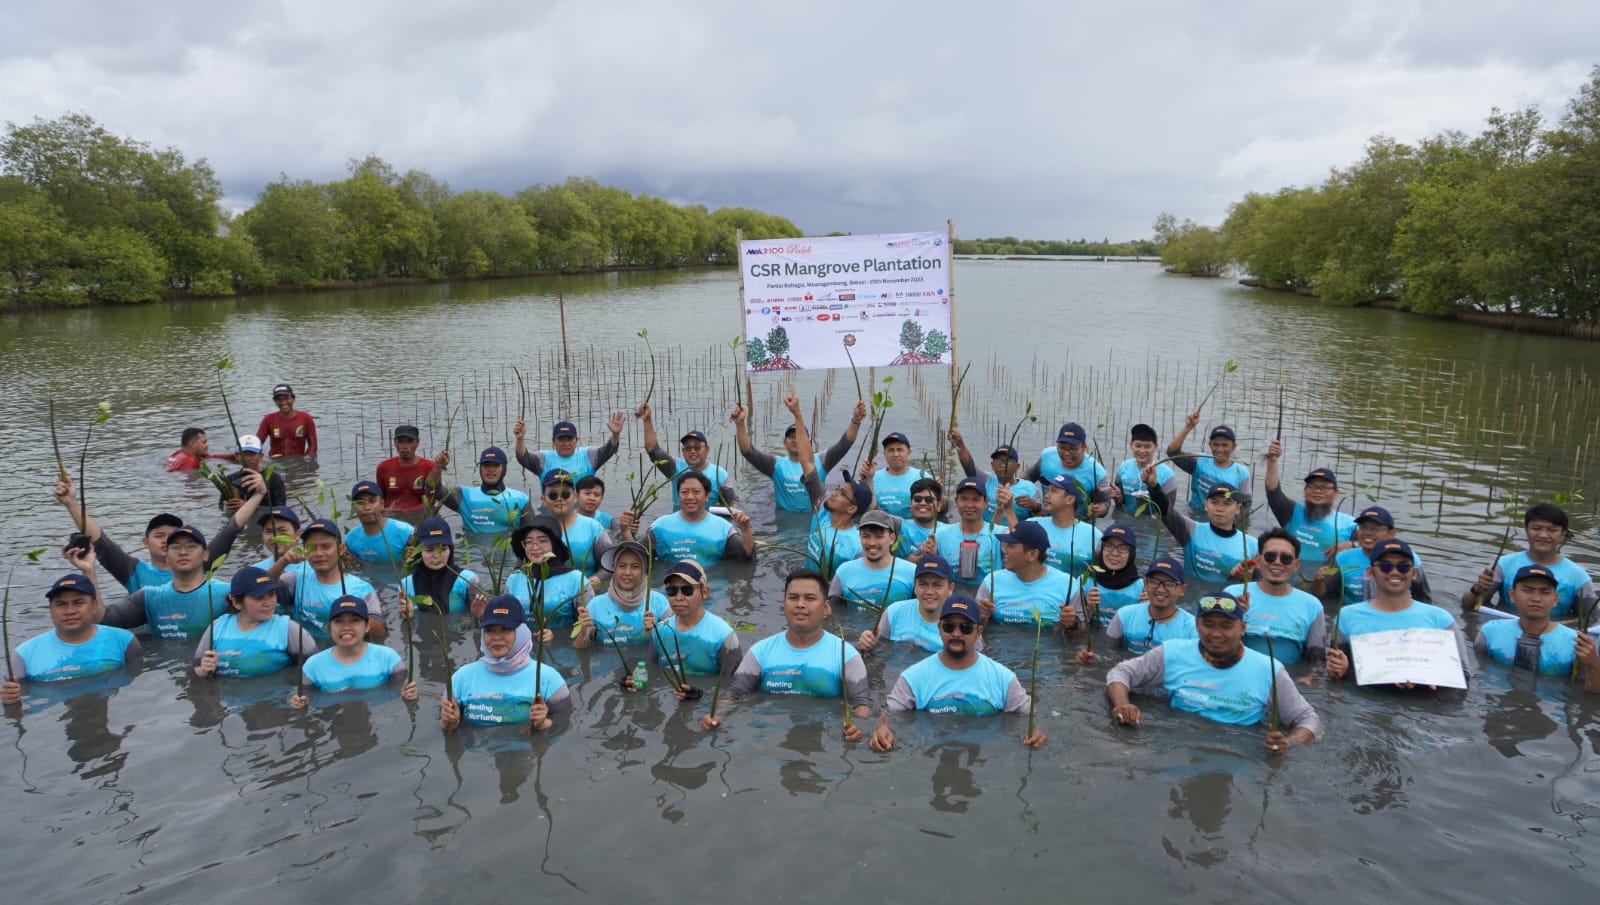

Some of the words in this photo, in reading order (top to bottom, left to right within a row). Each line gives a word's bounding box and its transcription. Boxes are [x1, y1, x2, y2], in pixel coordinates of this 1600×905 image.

[750, 263, 781, 278] CSR
[784, 261, 860, 278] Mangrove
[863, 255, 942, 273] Plantation
[882, 276, 910, 284] November
